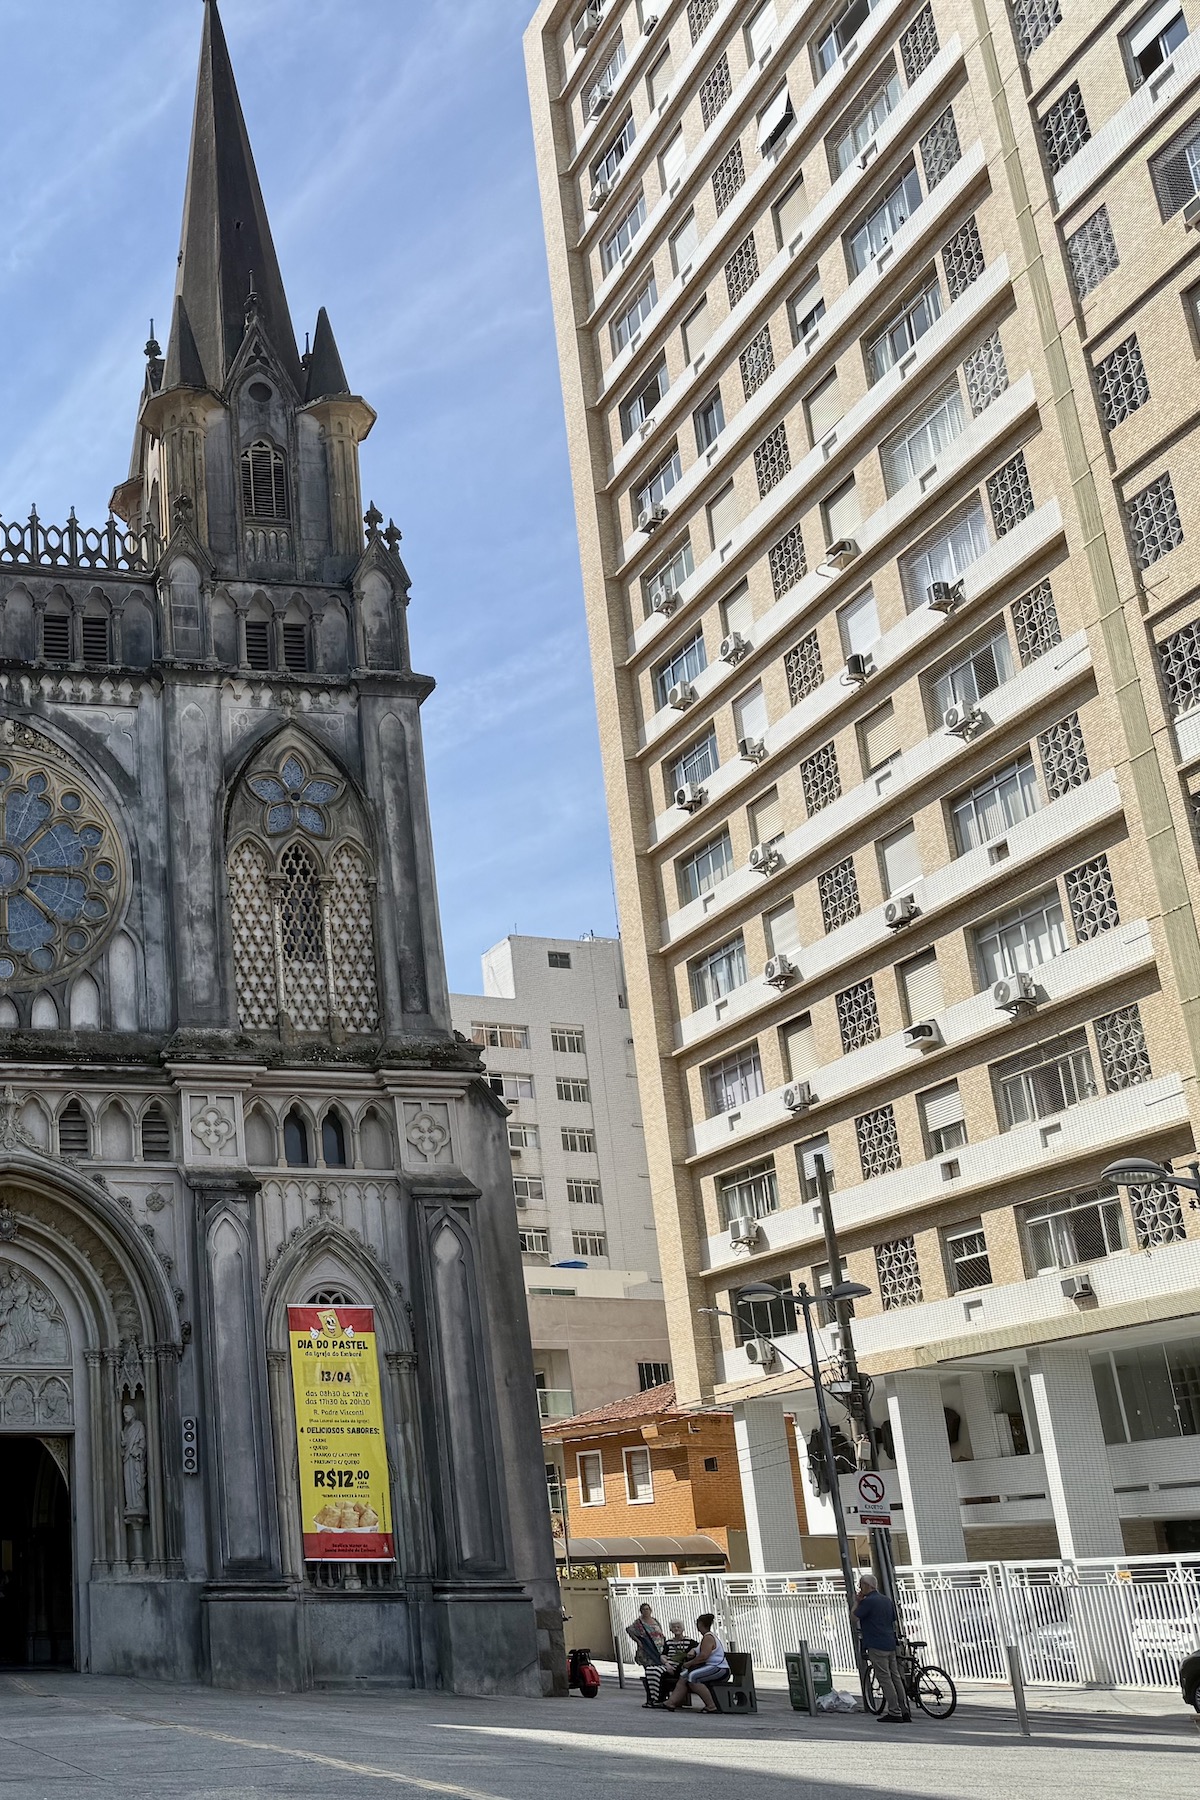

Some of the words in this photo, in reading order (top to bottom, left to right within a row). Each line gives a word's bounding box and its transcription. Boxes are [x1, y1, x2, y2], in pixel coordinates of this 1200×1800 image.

[298, 1340, 312, 1348] DIA
[317, 1340, 328, 1348] DO
[333, 1341, 368, 1350] PASTEL
[321, 1371, 351, 1383] 13/04
